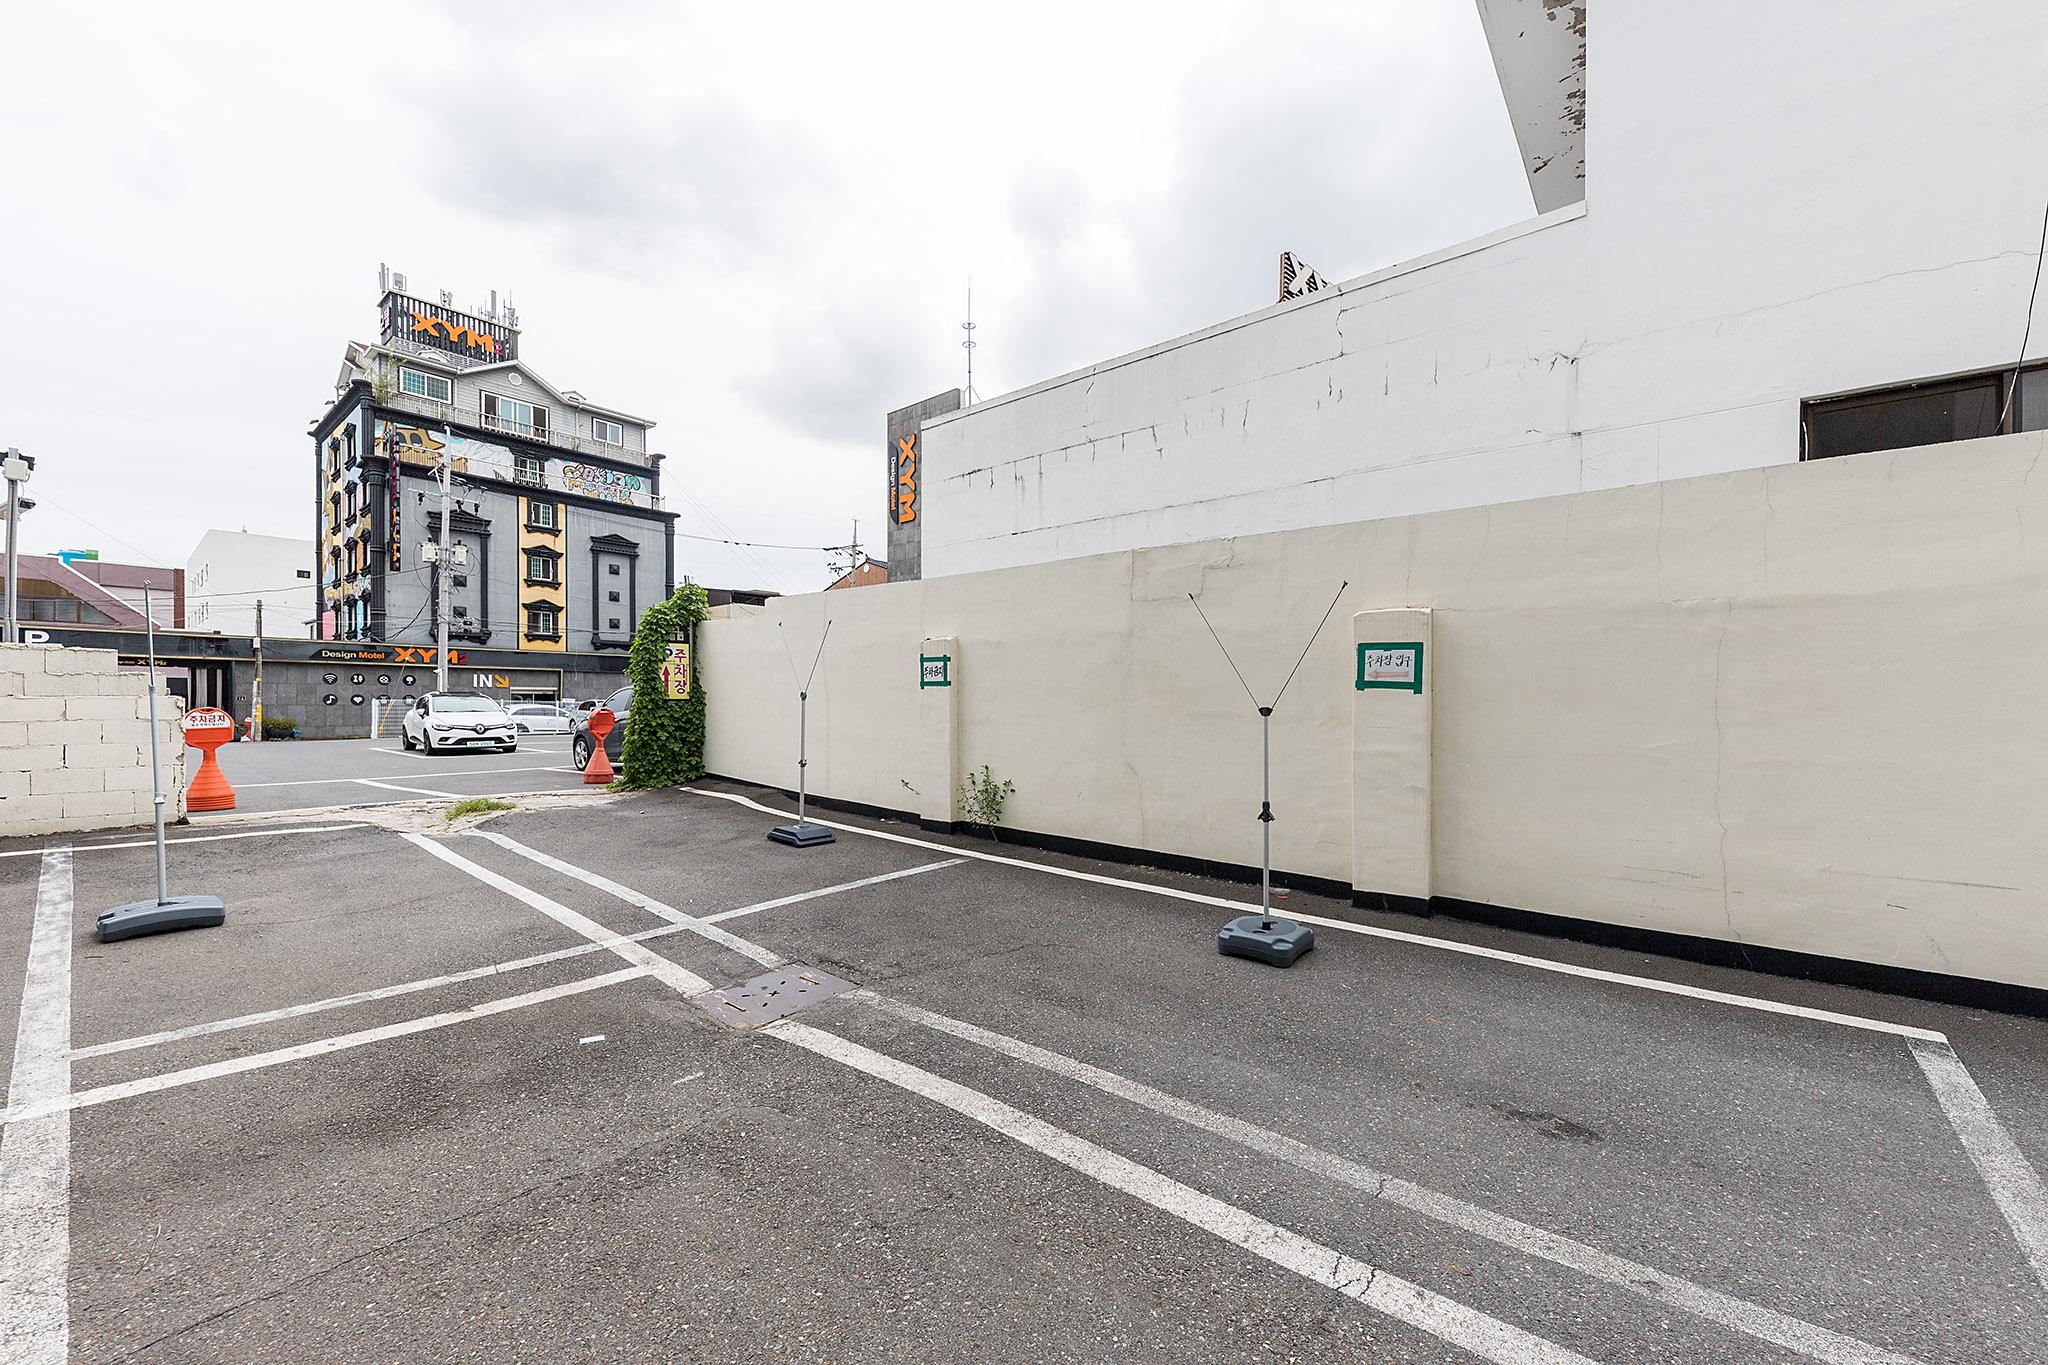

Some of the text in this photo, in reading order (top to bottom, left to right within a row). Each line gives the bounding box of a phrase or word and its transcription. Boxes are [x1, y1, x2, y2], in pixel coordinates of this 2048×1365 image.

[899, 434, 917, 524] XYM
[321, 649, 357, 660] Design
[358, 650, 385, 660] Motel
[472, 673, 493, 688] IN
[674, 648, 688, 694] 주차장
